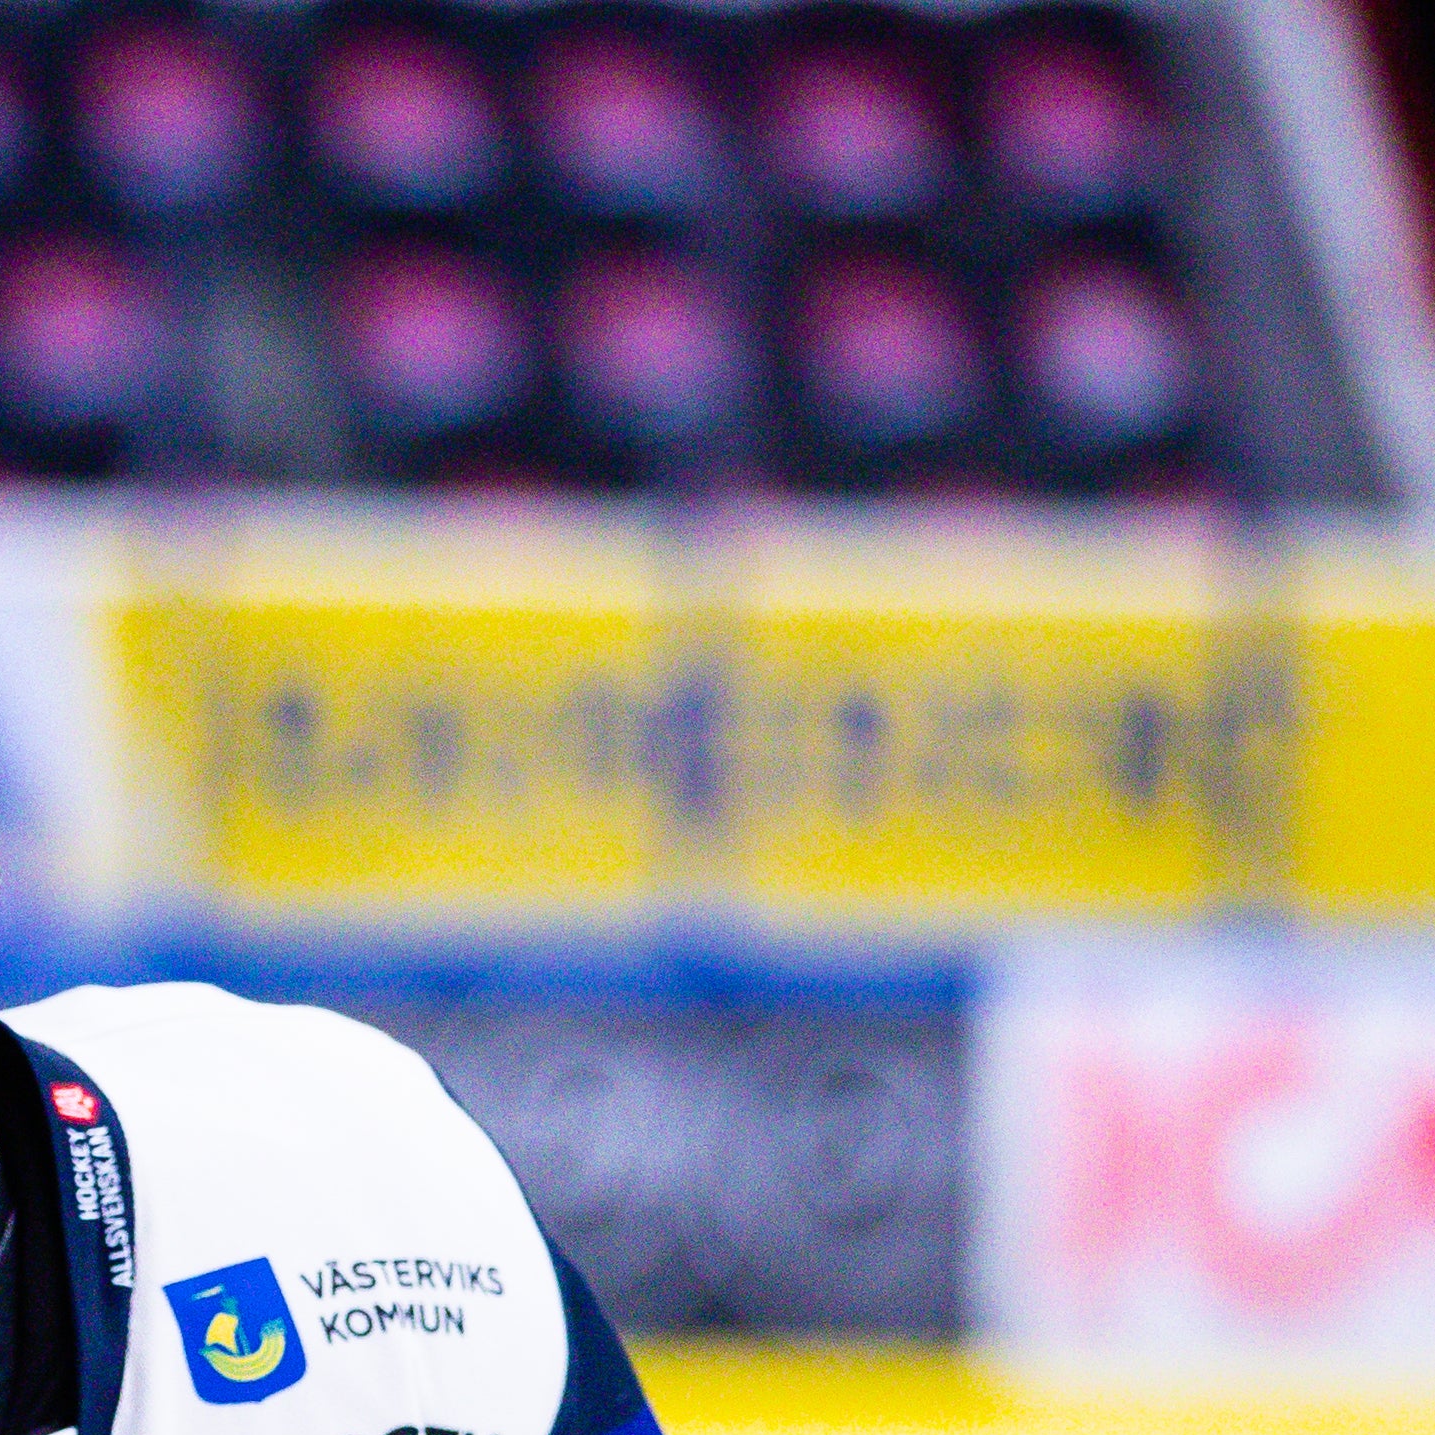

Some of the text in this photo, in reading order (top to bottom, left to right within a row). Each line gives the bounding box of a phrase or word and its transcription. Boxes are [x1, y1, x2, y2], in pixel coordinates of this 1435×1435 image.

[66, 1125, 101, 1221] HOCKEY
[86, 1125, 134, 1288] ALLSVENSKAN
[299, 1259, 504, 1299] VÄSTERVIKS
